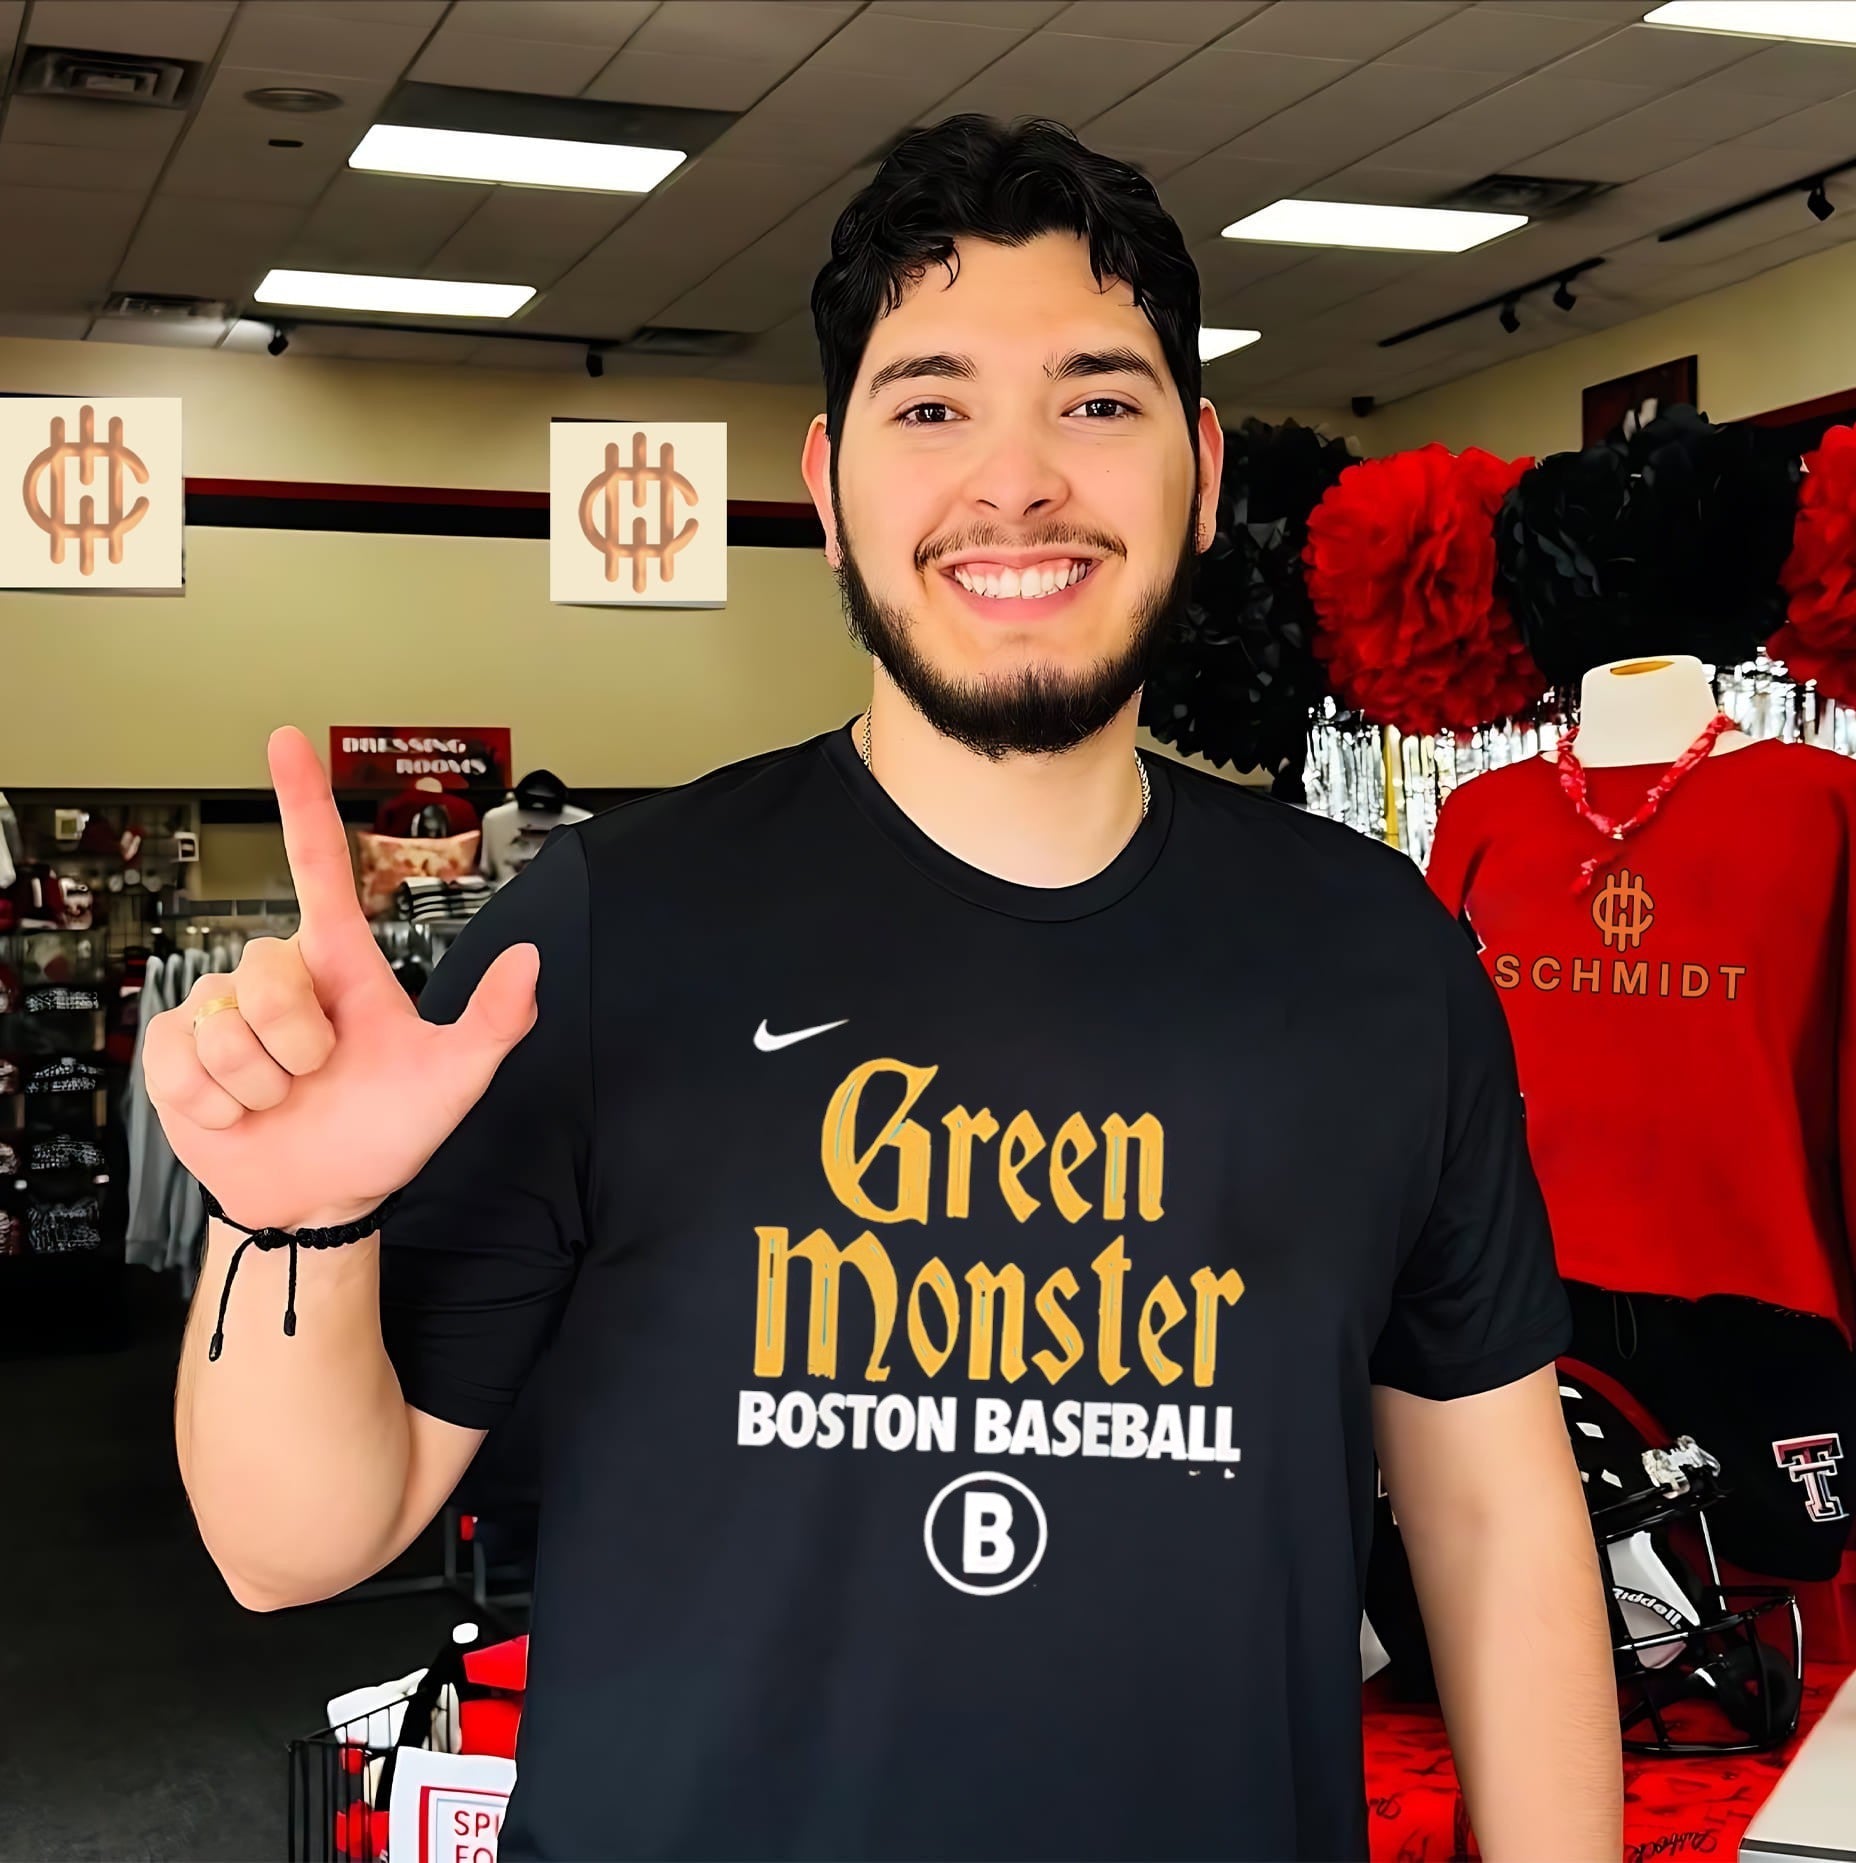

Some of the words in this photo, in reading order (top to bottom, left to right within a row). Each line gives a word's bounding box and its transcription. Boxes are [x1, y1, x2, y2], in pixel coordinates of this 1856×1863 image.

[341, 737, 467, 754] DRESSING
[395, 758, 487, 775] ROOMS
[1494, 954, 1746, 1000] SCHMIDT
[820, 1058, 1165, 1225] Green
[753, 1226, 1246, 1387] Monster
[737, 1390, 957, 1452] BOSTON
[974, 1397, 1241, 1462] BASEBALL
[962, 1490, 1016, 1575] B
